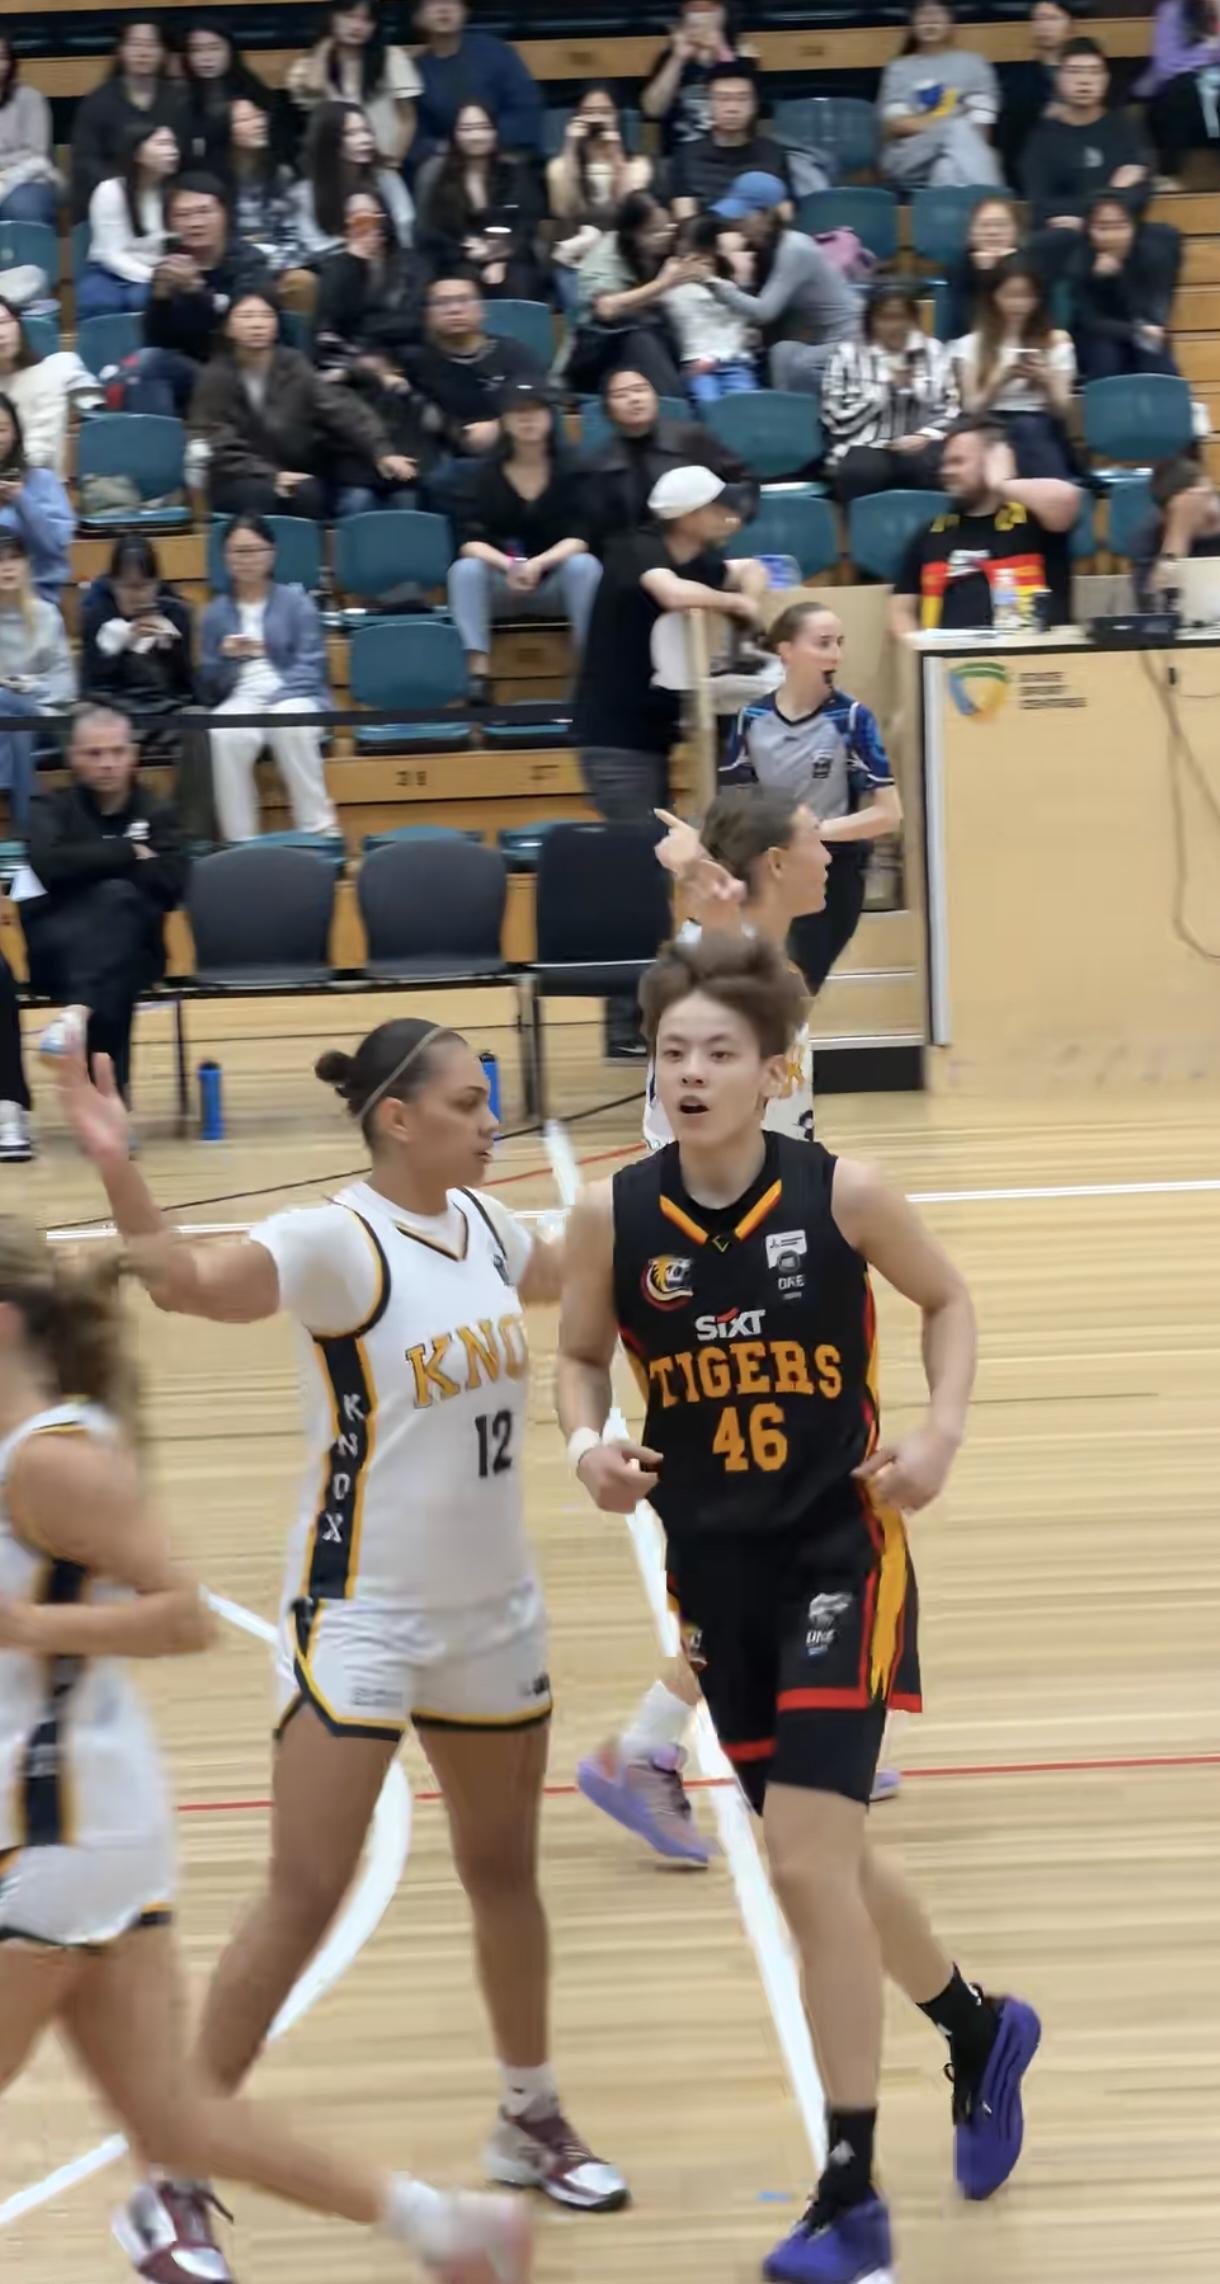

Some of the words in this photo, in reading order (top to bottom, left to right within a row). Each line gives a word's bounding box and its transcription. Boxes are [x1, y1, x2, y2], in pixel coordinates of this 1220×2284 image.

[649, 1340, 842, 1408] TIGERS
[322, 1393, 365, 1543] KNOX
[474, 1409, 512, 1478] 12
[712, 1402, 788, 1472] 46
